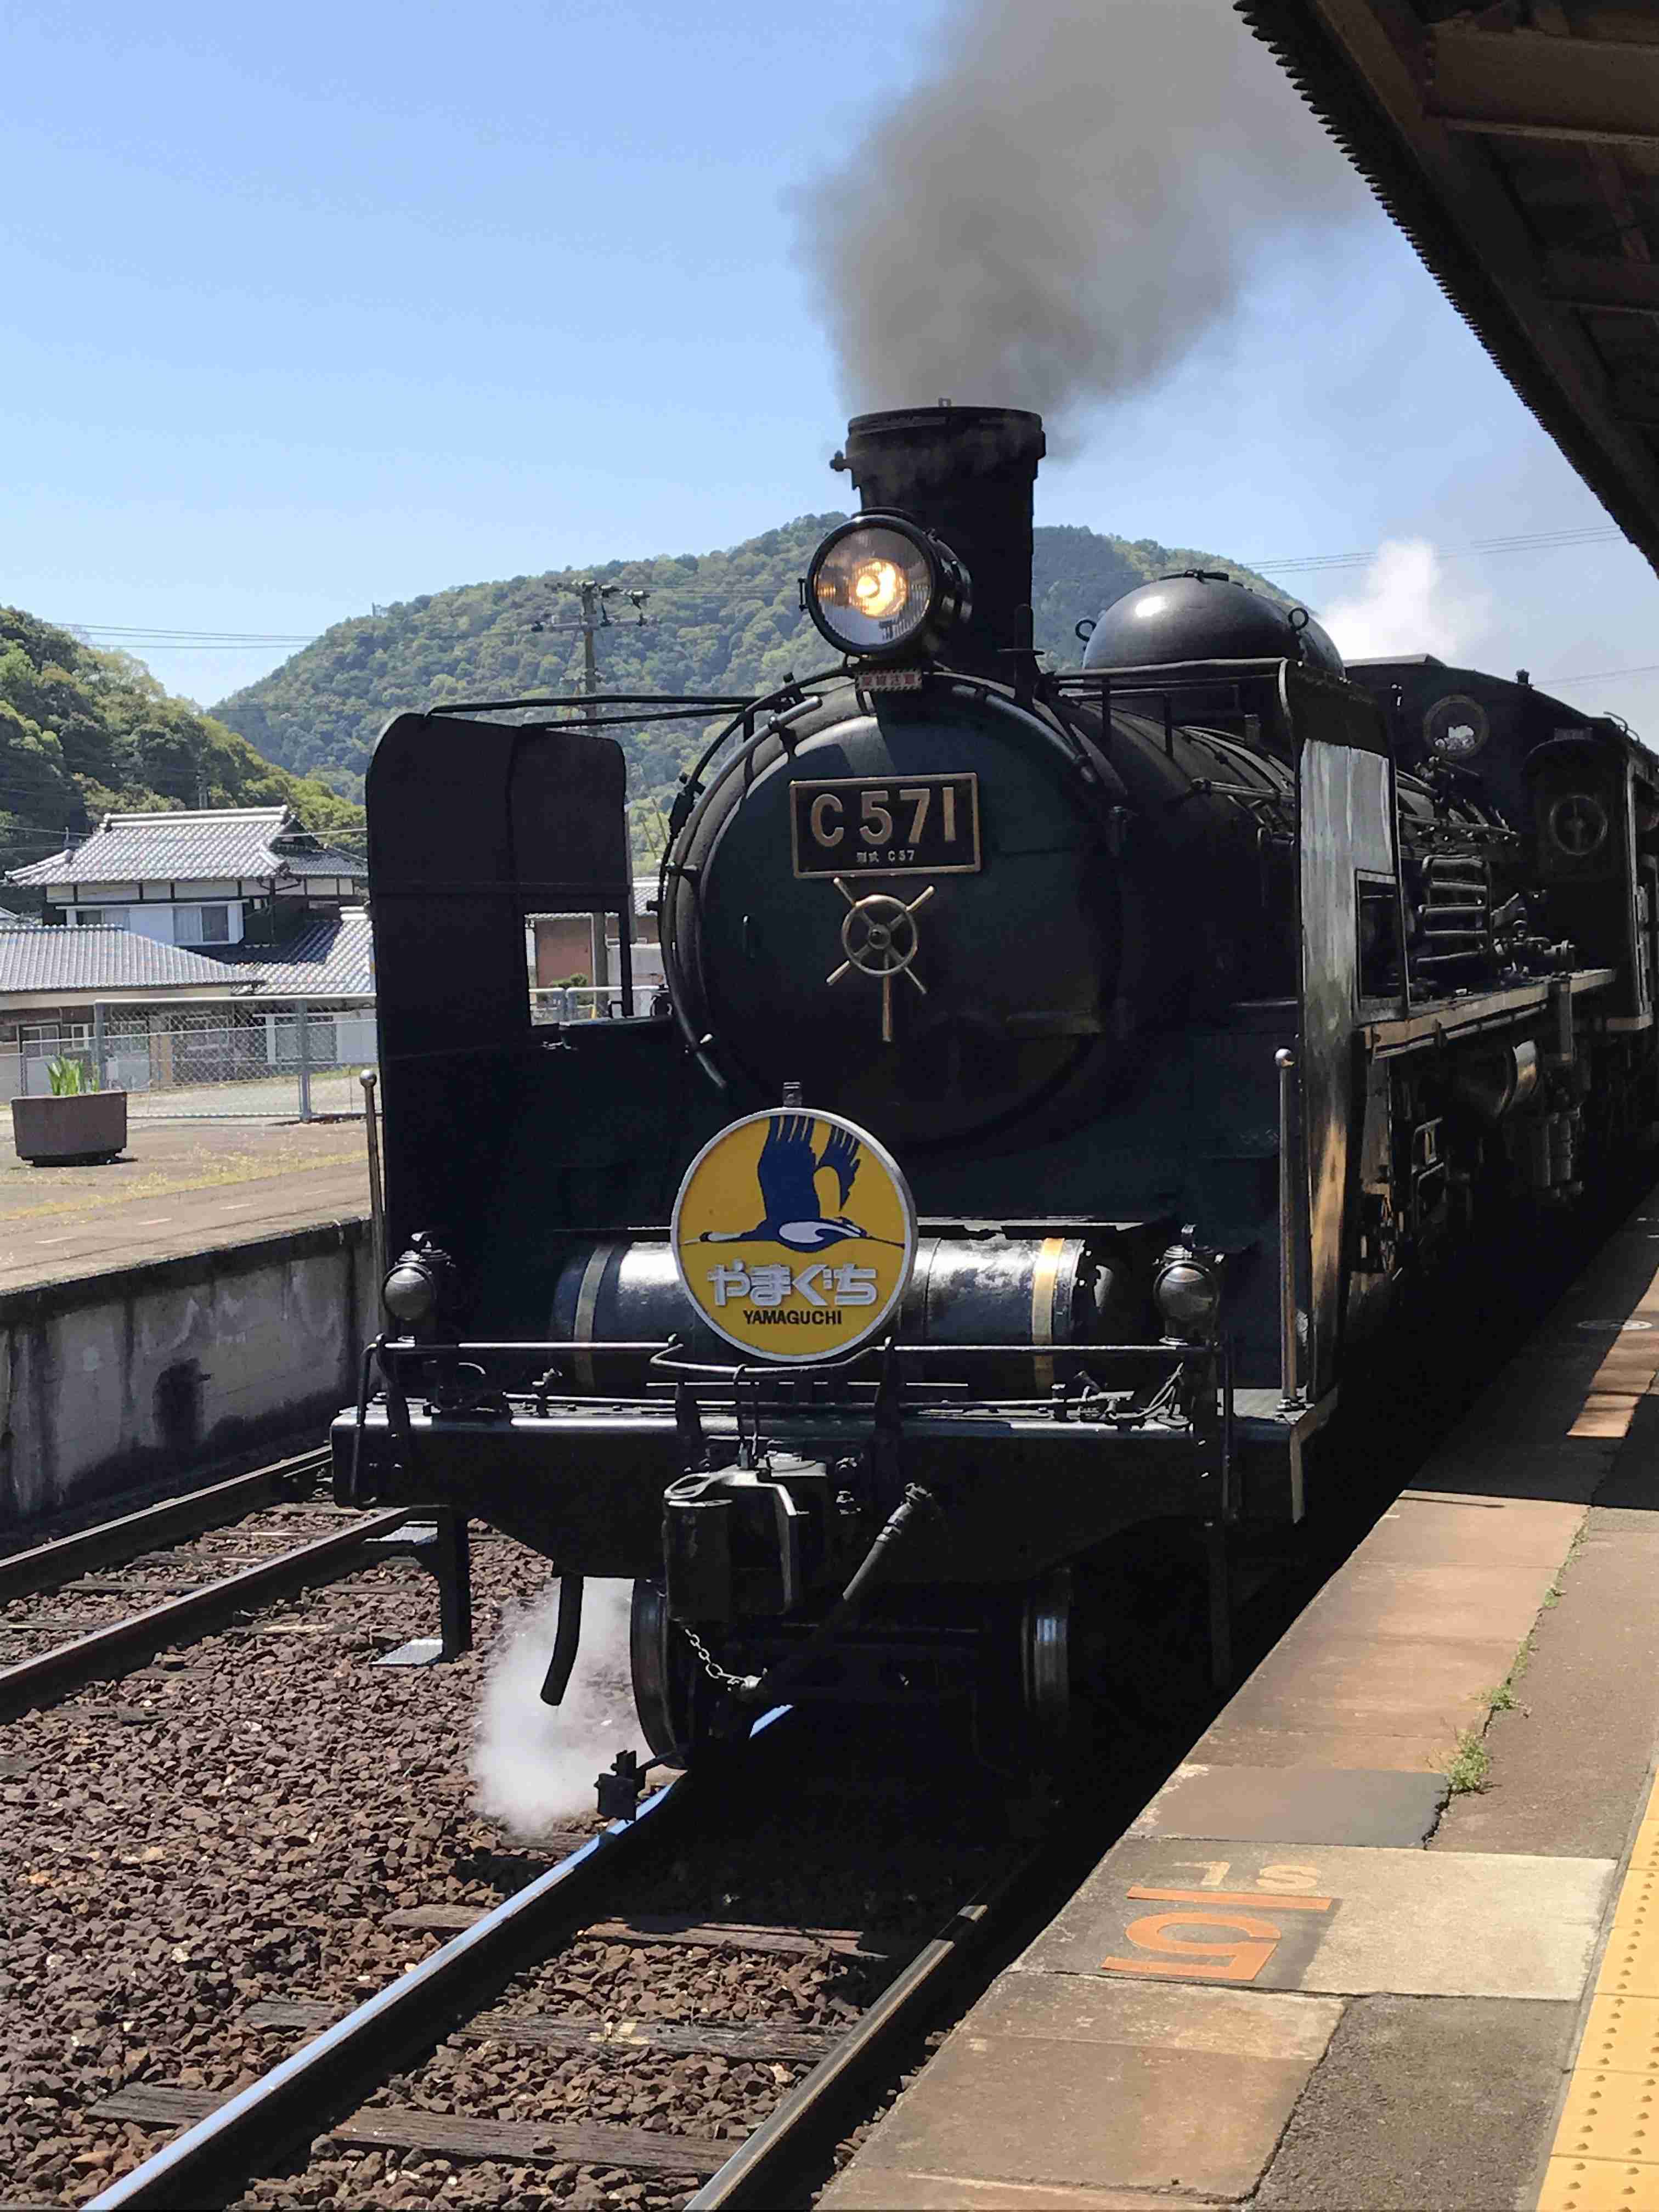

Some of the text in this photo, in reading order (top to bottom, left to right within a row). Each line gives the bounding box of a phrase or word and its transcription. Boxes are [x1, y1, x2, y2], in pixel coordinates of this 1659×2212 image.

[887, 850, 915, 862] C57
[707, 1259, 878, 1306] やまぐち
[743, 1310, 842, 1325] YAMAGUCHI
